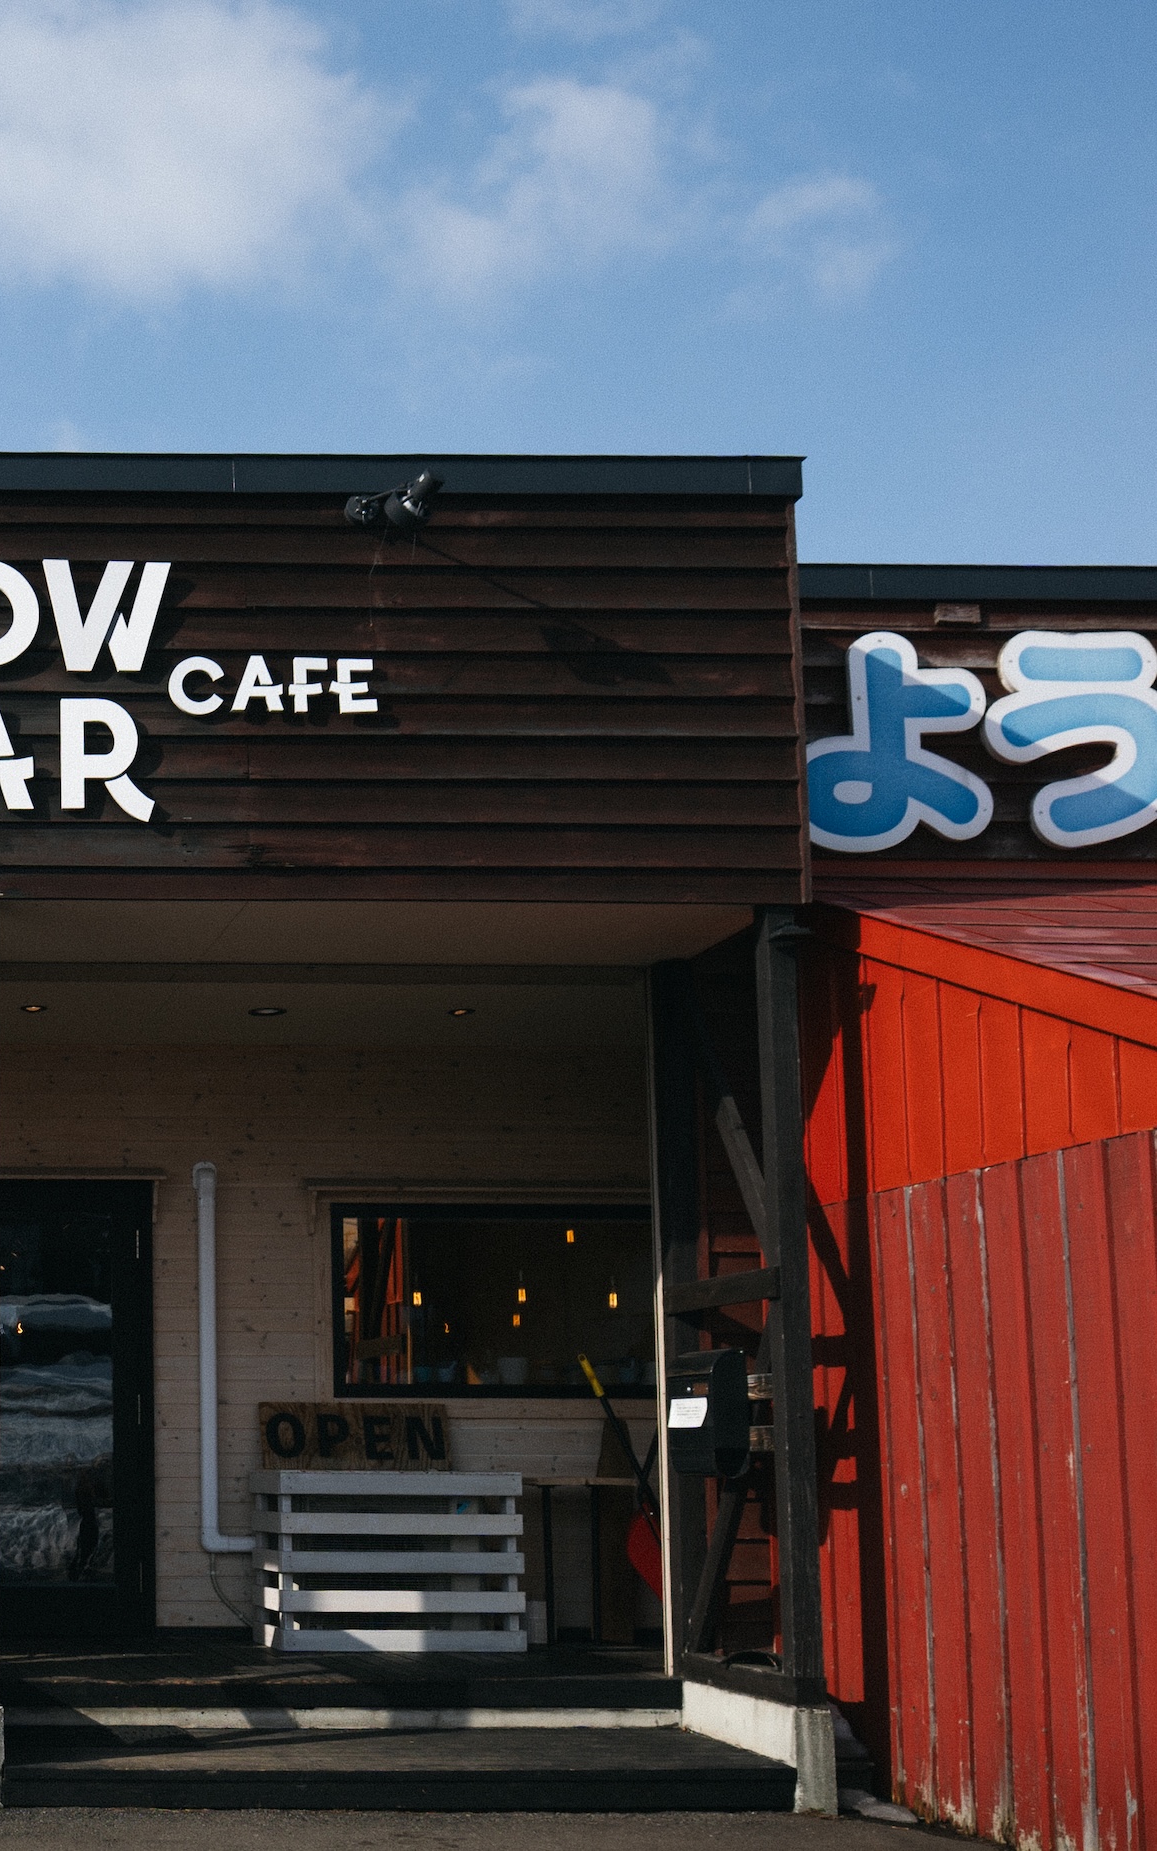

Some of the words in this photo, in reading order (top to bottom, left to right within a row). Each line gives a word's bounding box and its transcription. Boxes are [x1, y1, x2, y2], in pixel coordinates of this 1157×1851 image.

[168, 655, 379, 716] CAFE
[806, 630, 1157, 853] よう
[265, 1412, 446, 1461] OPEN
